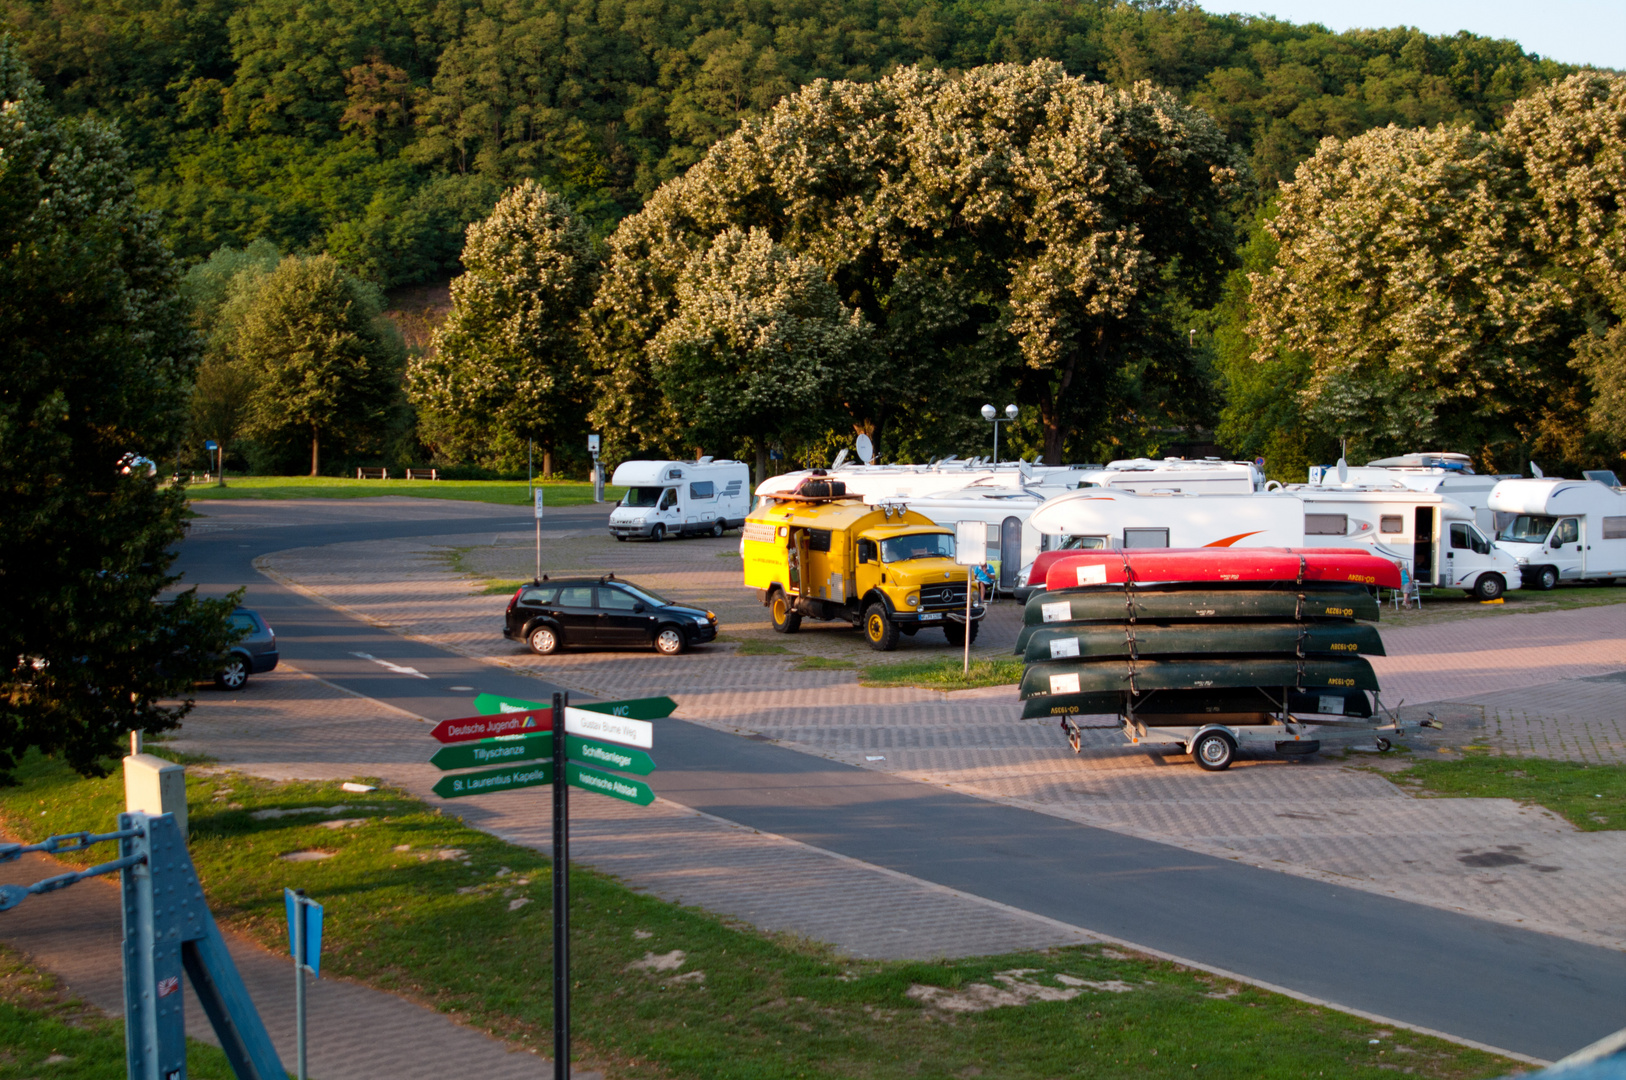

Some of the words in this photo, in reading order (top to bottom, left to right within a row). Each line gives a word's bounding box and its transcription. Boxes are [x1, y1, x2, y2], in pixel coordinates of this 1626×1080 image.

[1348, 574, 1375, 583] GÖ-1924V
[1325, 608, 1353, 617] GÖ-1923V
[612, 705, 629, 716] WC
[448, 722, 485, 736] Deutsche
[580, 717, 600, 730] Gustav
[602, 721, 621, 735] Blume
[622, 725, 637, 740] Weg
[473, 745, 525, 761] Tillyschanze
[582, 745, 632, 766] Schiffsanleger
[453, 779, 465, 791] St.
[467, 774, 511, 789] Laurentius
[512, 769, 544, 784] Kapelle
[579, 771, 613, 791] historische
[612, 781, 638, 798] Altstadt
